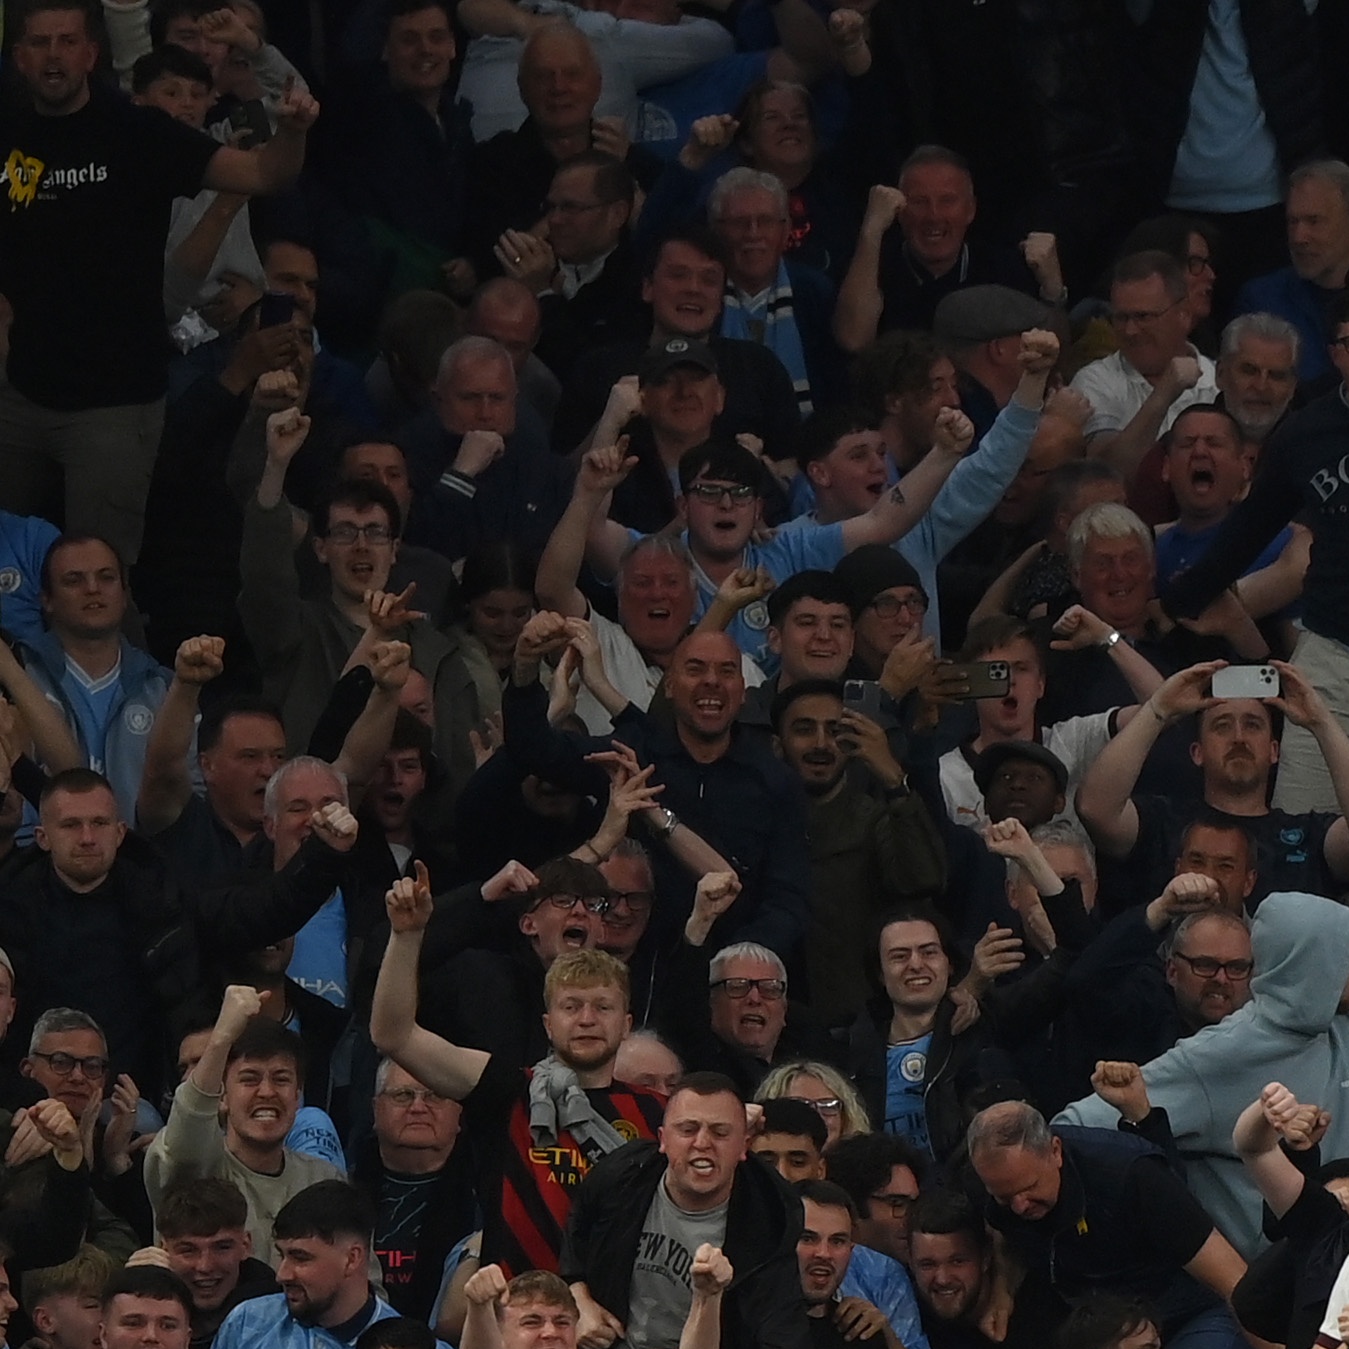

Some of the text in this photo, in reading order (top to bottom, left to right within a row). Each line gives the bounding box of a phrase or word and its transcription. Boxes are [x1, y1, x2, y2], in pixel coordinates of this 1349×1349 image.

[42, 162, 109, 191] Angels
[547, 1171, 592, 1185] AIR
[668, 1242, 696, 1287] YOR
